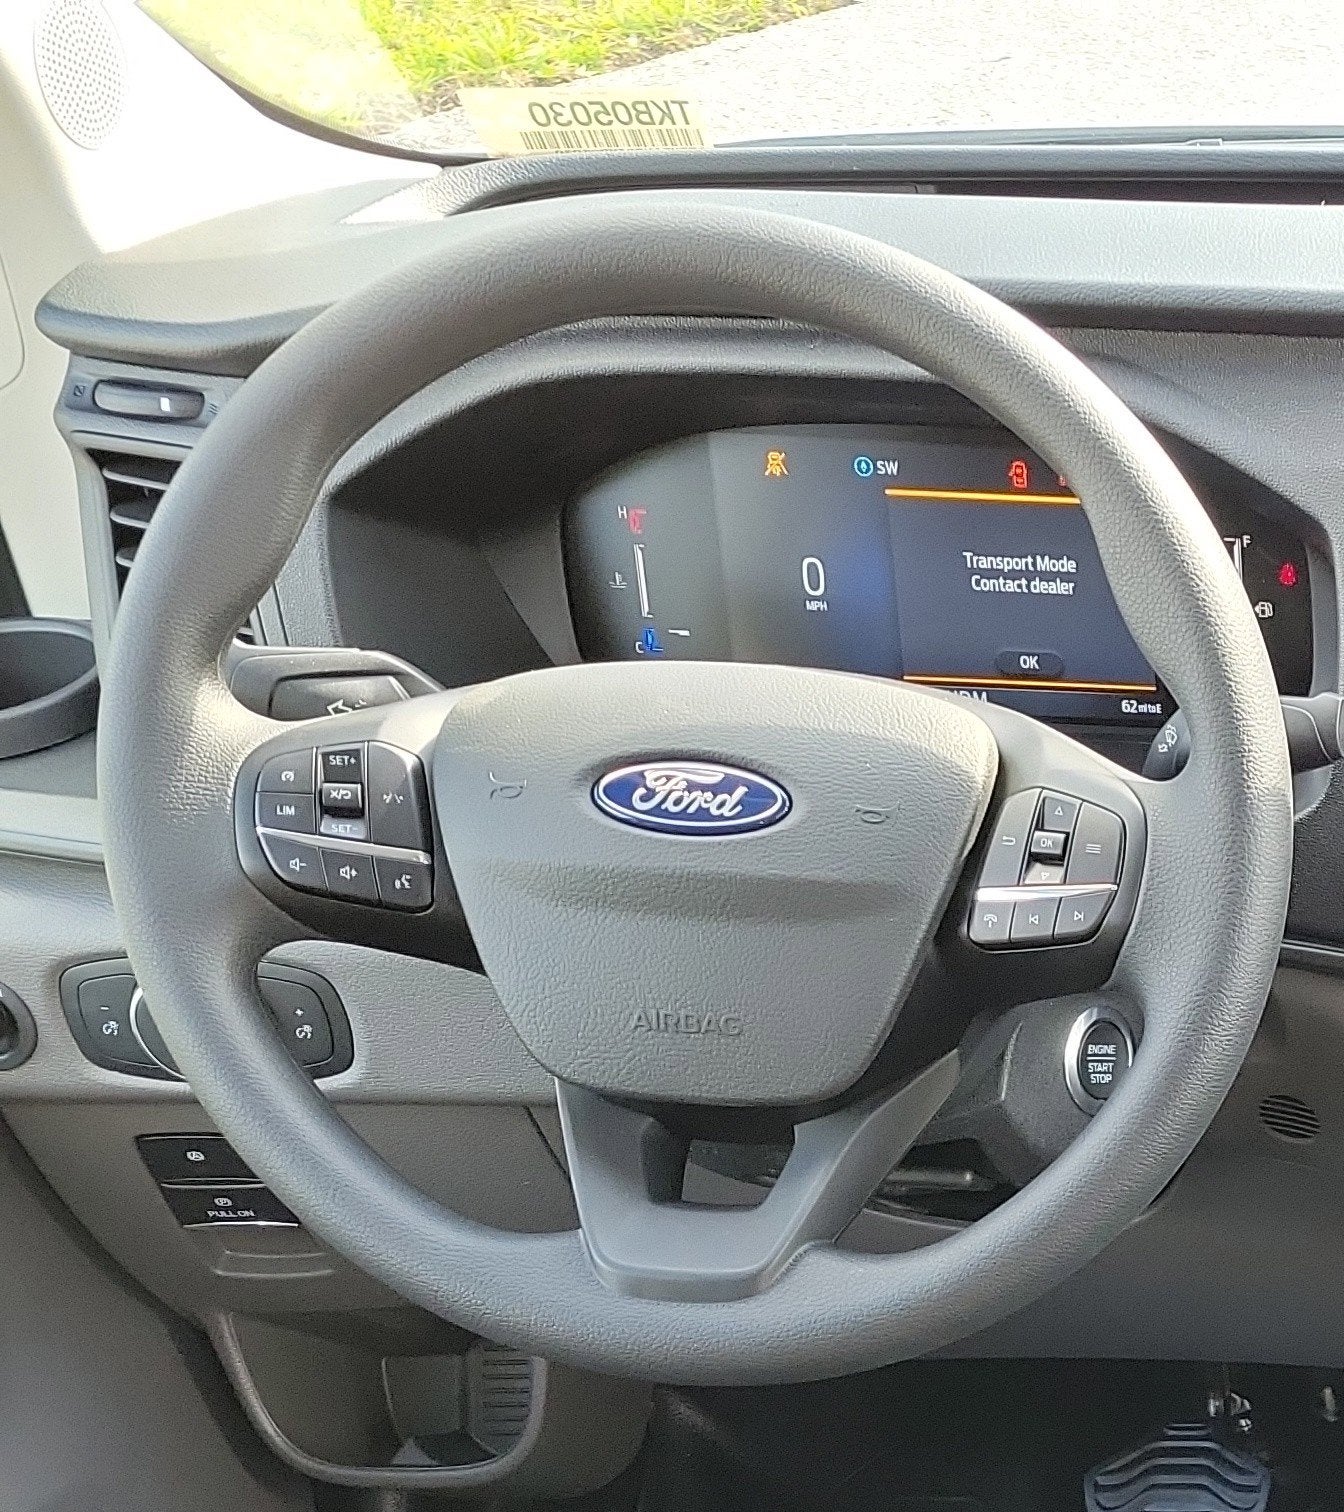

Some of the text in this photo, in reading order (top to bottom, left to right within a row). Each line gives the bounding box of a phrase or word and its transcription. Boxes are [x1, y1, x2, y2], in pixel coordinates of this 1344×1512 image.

[876, 460, 898, 476] SW
[618, 506, 627, 518] H
[1242, 535, 1251, 548] F
[963, 552, 1077, 573] Transport Mode
[802, 557, 825, 596] 0
[971, 574, 1074, 595] Contact dealer
[805, 600, 828, 611] MPH
[635, 642, 644, 653] C
[1019, 655, 1039, 670] OK
[1121, 699, 1138, 713] 62
[329, 755, 357, 766] SET+
[632, 769, 748, 817] Ford
[276, 805, 295, 816] LIM
[1040, 838, 1053, 849] OK
[632, 1009, 742, 1036] AIRBAG
[1087, 1044, 1117, 1055] ENGINE
[1088, 1063, 1114, 1073] START
[1090, 1073, 1112, 1084] STOP
[207, 1210, 237, 1218] PULL
